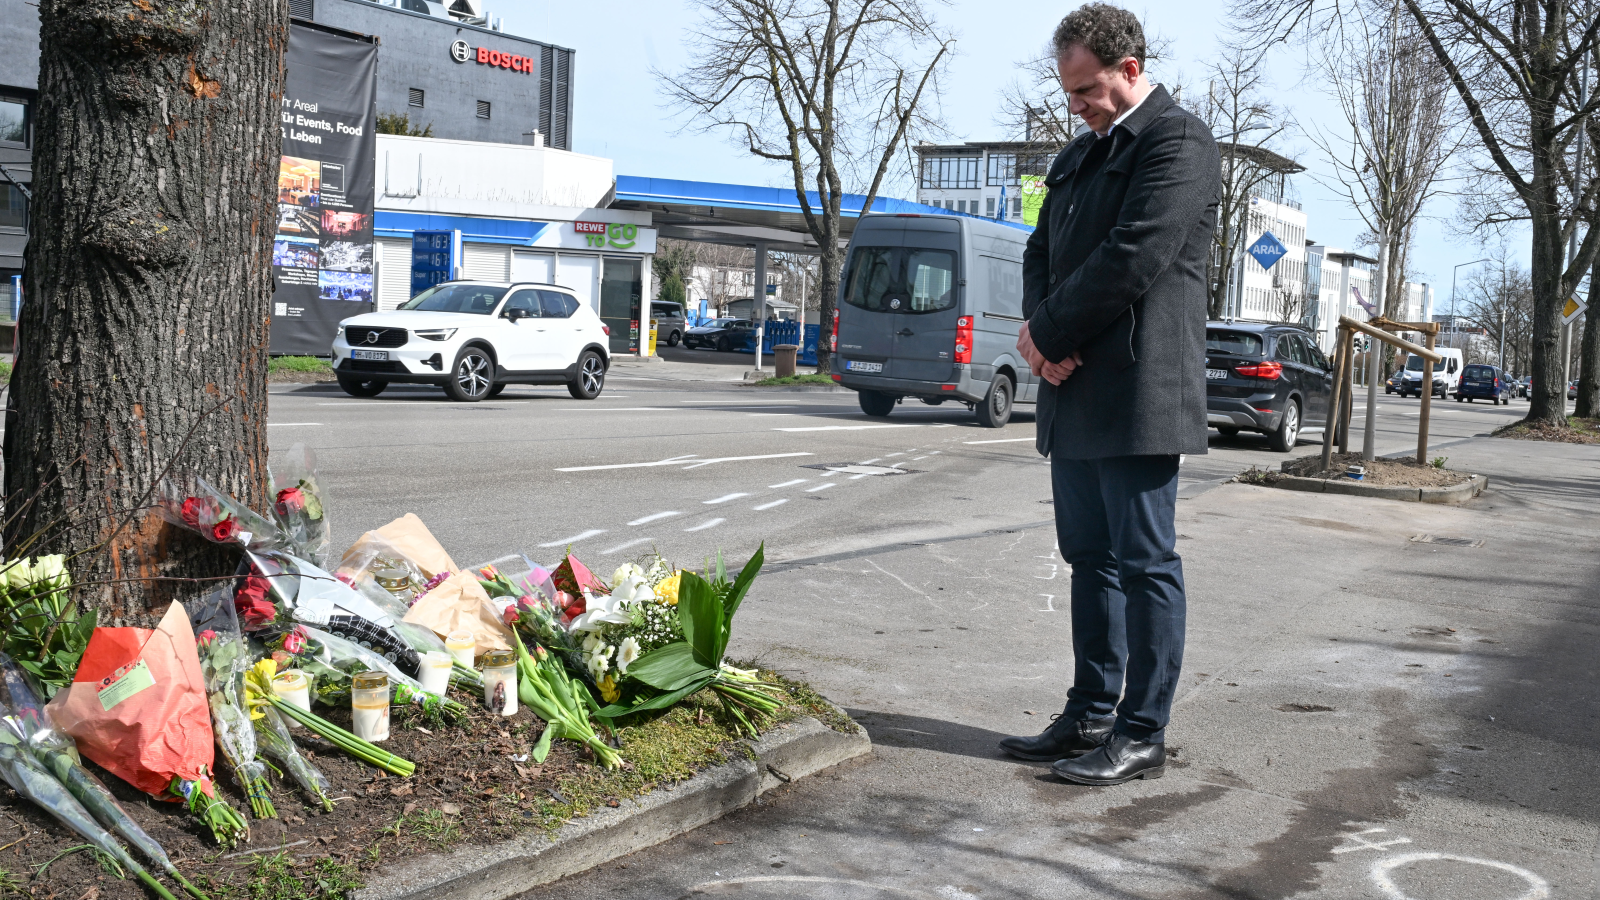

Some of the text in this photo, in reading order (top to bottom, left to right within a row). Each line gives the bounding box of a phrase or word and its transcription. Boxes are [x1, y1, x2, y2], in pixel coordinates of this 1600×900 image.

[477, 47, 534, 73] BOSCH
[282, 96, 318, 113] hr Areal
[296, 114, 334, 133] Events,
[337, 122, 363, 136] Food
[290, 129, 321, 144] Leben
[576, 223, 604, 232] REWE
[608, 223, 637, 240] GO
[586, 234, 606, 247] TO
[1252, 244, 1282, 255] ARAL
